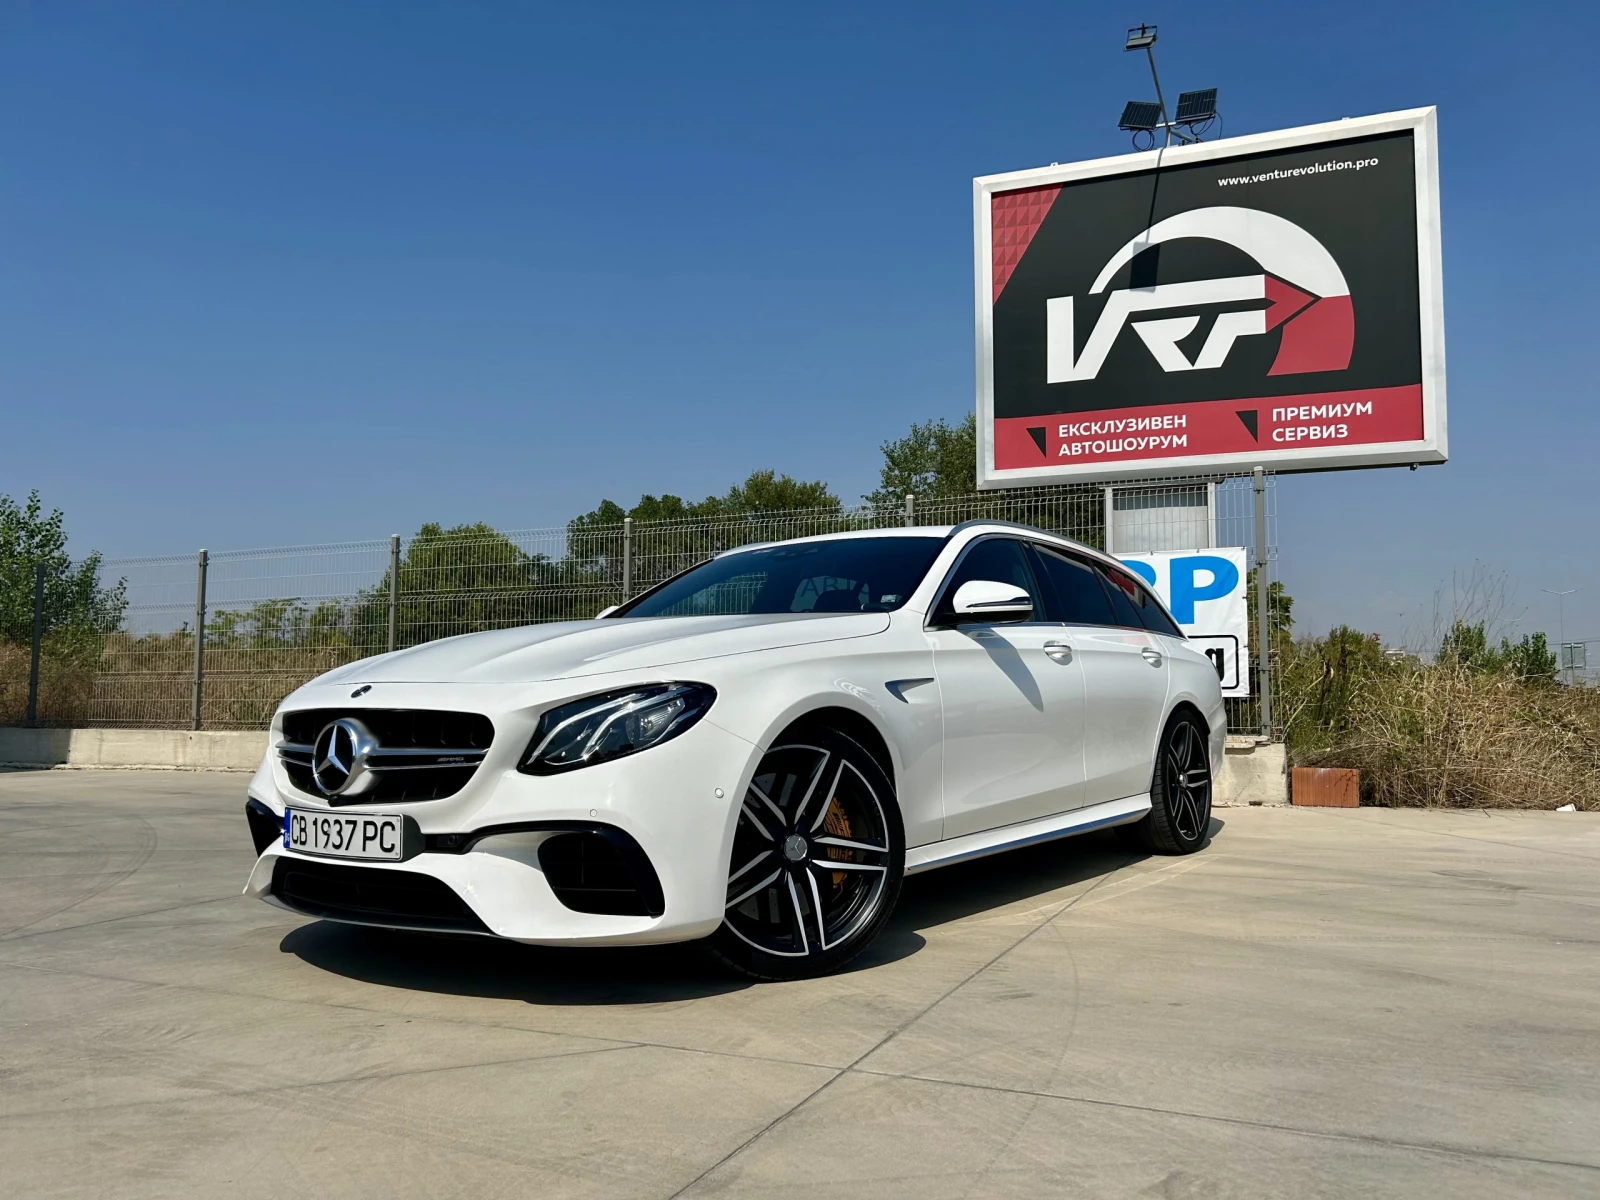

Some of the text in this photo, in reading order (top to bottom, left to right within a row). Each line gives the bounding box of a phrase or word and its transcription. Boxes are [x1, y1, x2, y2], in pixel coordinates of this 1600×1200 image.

[1217, 157, 1379, 187] www.venturevolution.pro
[1272, 401, 1373, 422] ПРЕМИУМ
[1058, 414, 1187, 438] ЕКСКЛУЗИВЕН
[1272, 424, 1348, 442] СЕРВИЗ
[1058, 434, 1188, 457] АВТОШОУРУМ
[312, 817, 358, 851] 1937
